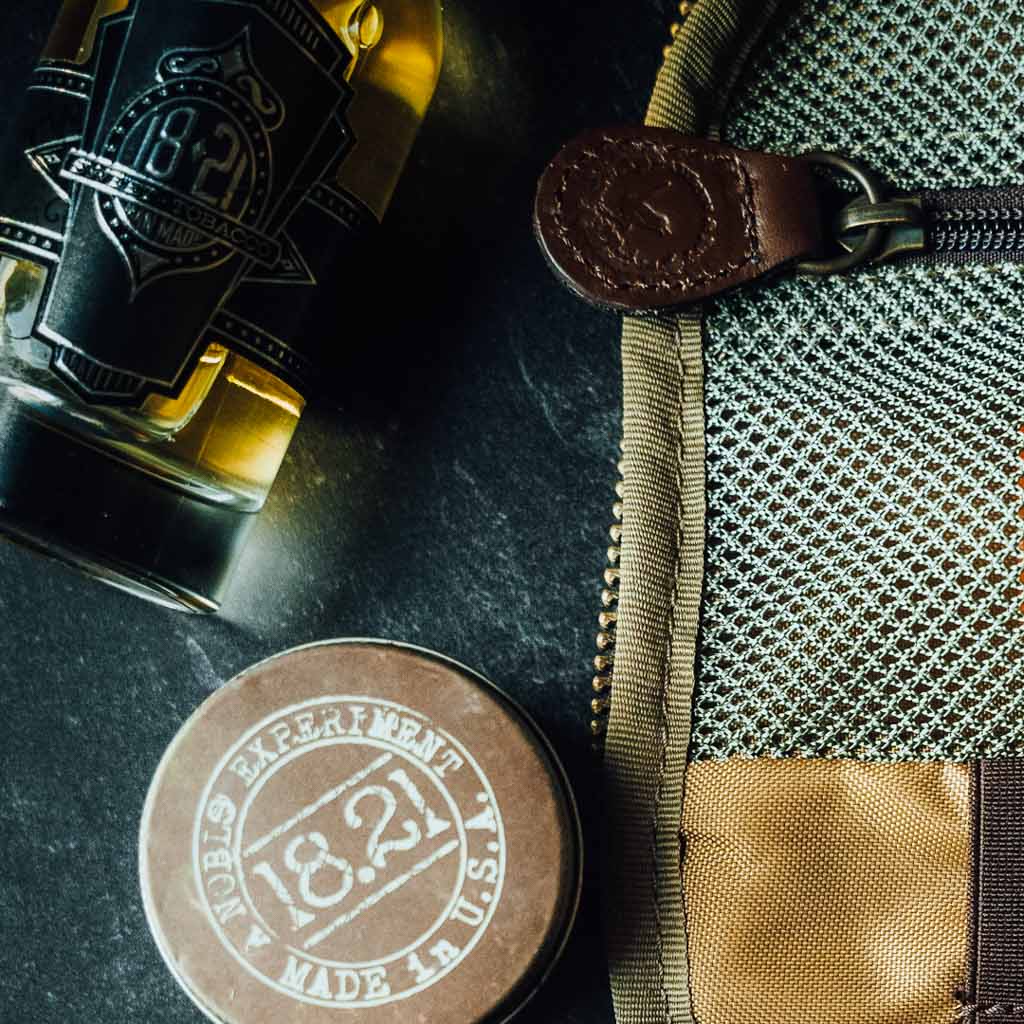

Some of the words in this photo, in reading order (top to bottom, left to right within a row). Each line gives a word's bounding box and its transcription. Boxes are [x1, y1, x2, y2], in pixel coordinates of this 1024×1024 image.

[230, 706, 463, 787] EXPERIMENT
[254, 770, 449, 929] 18.21
[280, 955, 391, 1000] MADE
